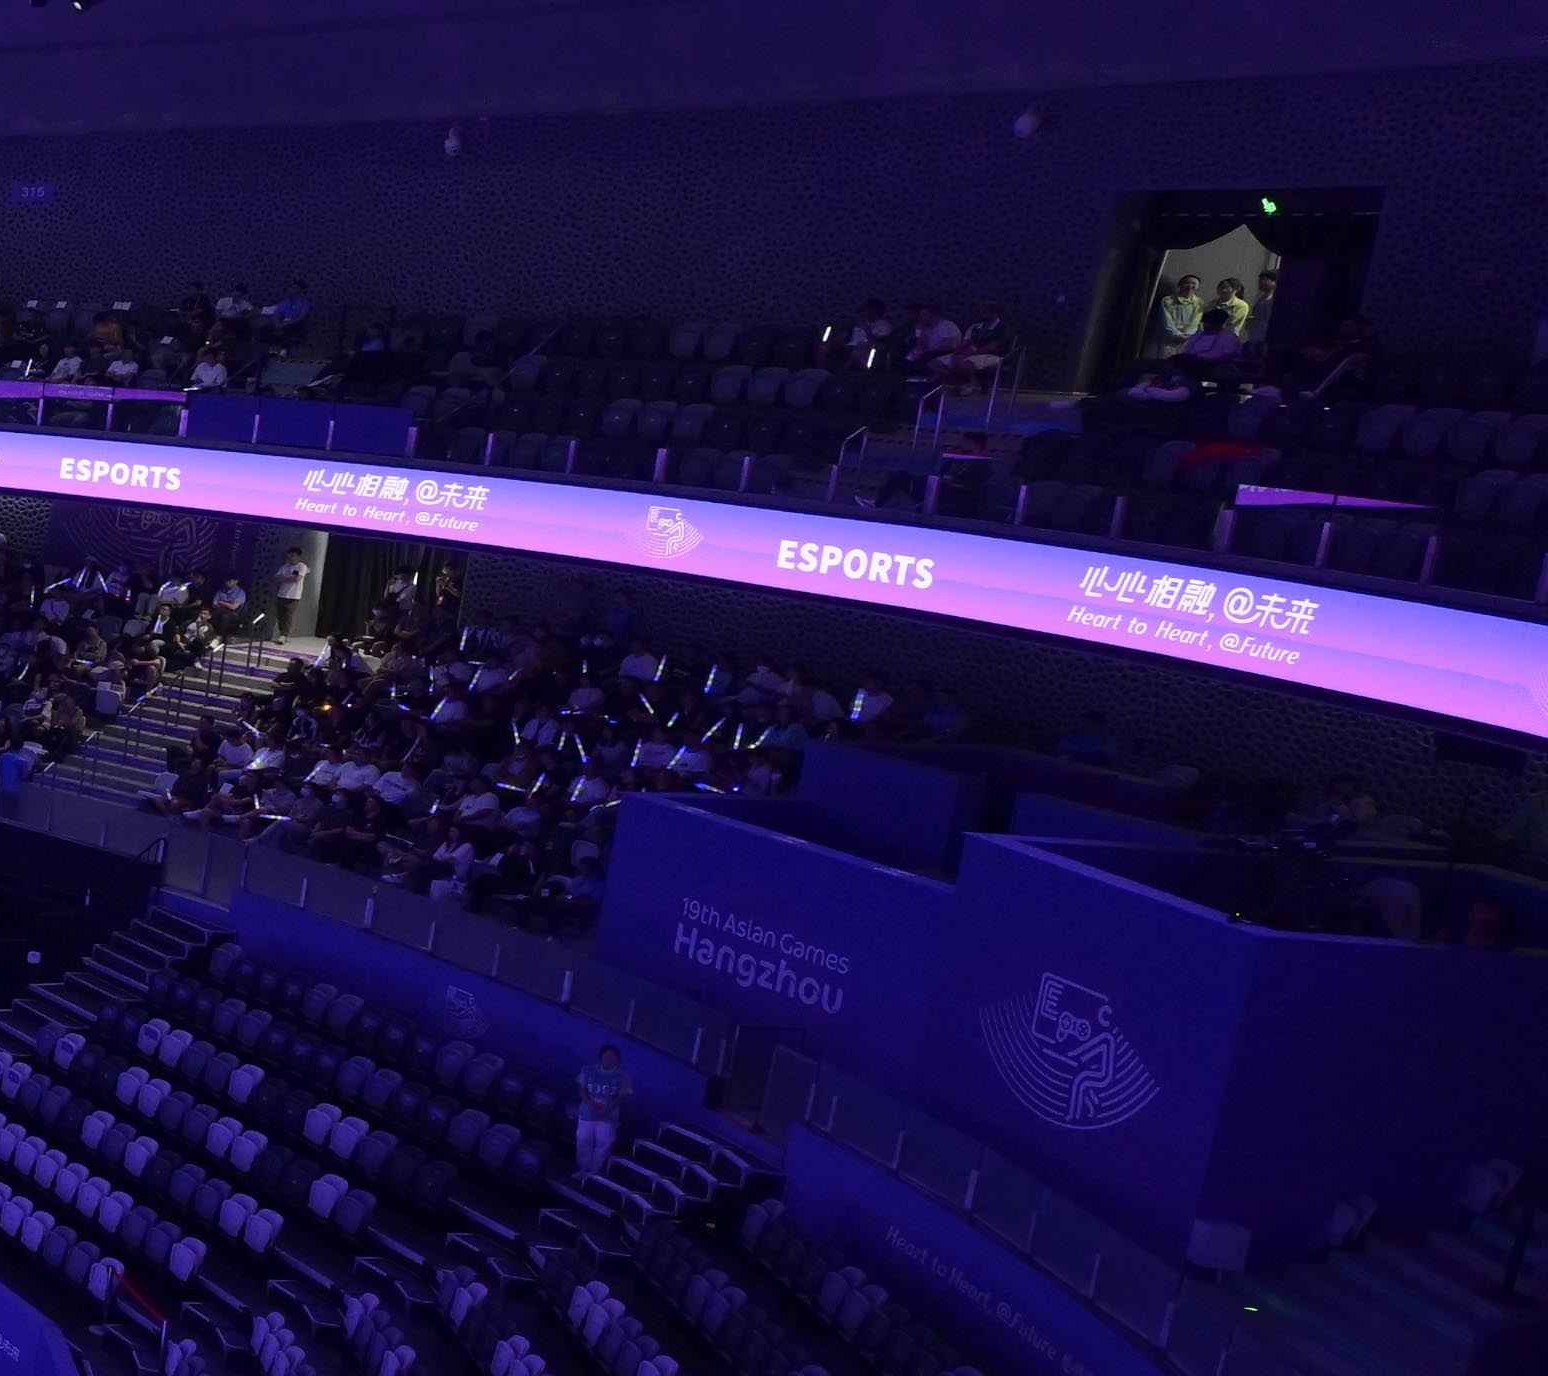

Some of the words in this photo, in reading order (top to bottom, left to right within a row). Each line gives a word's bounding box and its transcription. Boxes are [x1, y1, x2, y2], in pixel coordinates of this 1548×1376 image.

[59, 457, 182, 492] ESPORTS
[294, 497, 337, 516] Heart
[342, 503, 358, 518] to
[414, 511, 479, 533] @Future
[776, 539, 936, 590] ESPORTS
[1079, 565, 1320, 636] 心心相融,@未来
[1066, 604, 1123, 632] Heart
[1127, 616, 1149, 636] to
[1219, 632, 1301, 665] @Future
[683, 897, 720, 929] 19th
[722, 912, 777, 949] Asian
[779, 932, 850, 975] Games
[674, 922, 844, 1015] Hangzhou
